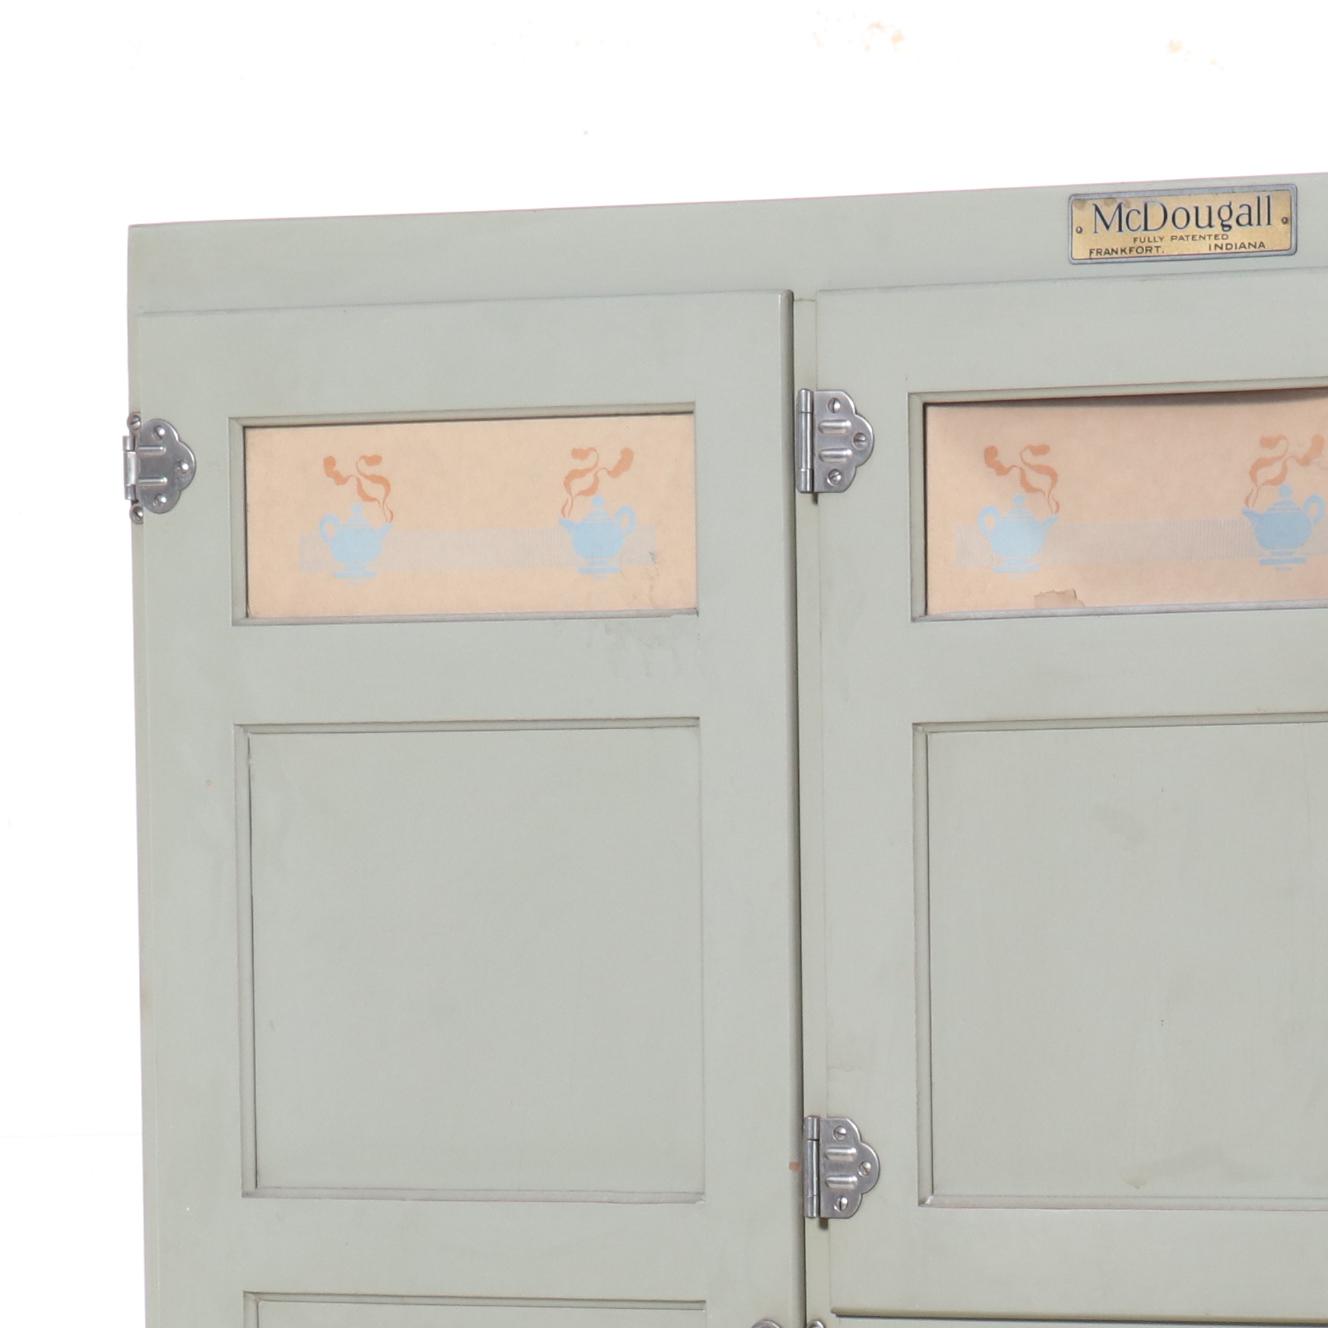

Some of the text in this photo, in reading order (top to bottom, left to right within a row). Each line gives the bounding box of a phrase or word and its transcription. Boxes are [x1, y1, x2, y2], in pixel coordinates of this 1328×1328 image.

[1092, 194, 1272, 232] McDougall
[1133, 233, 1229, 244] FULLY PATENTED
[1208, 241, 1266, 251] INDIANA
